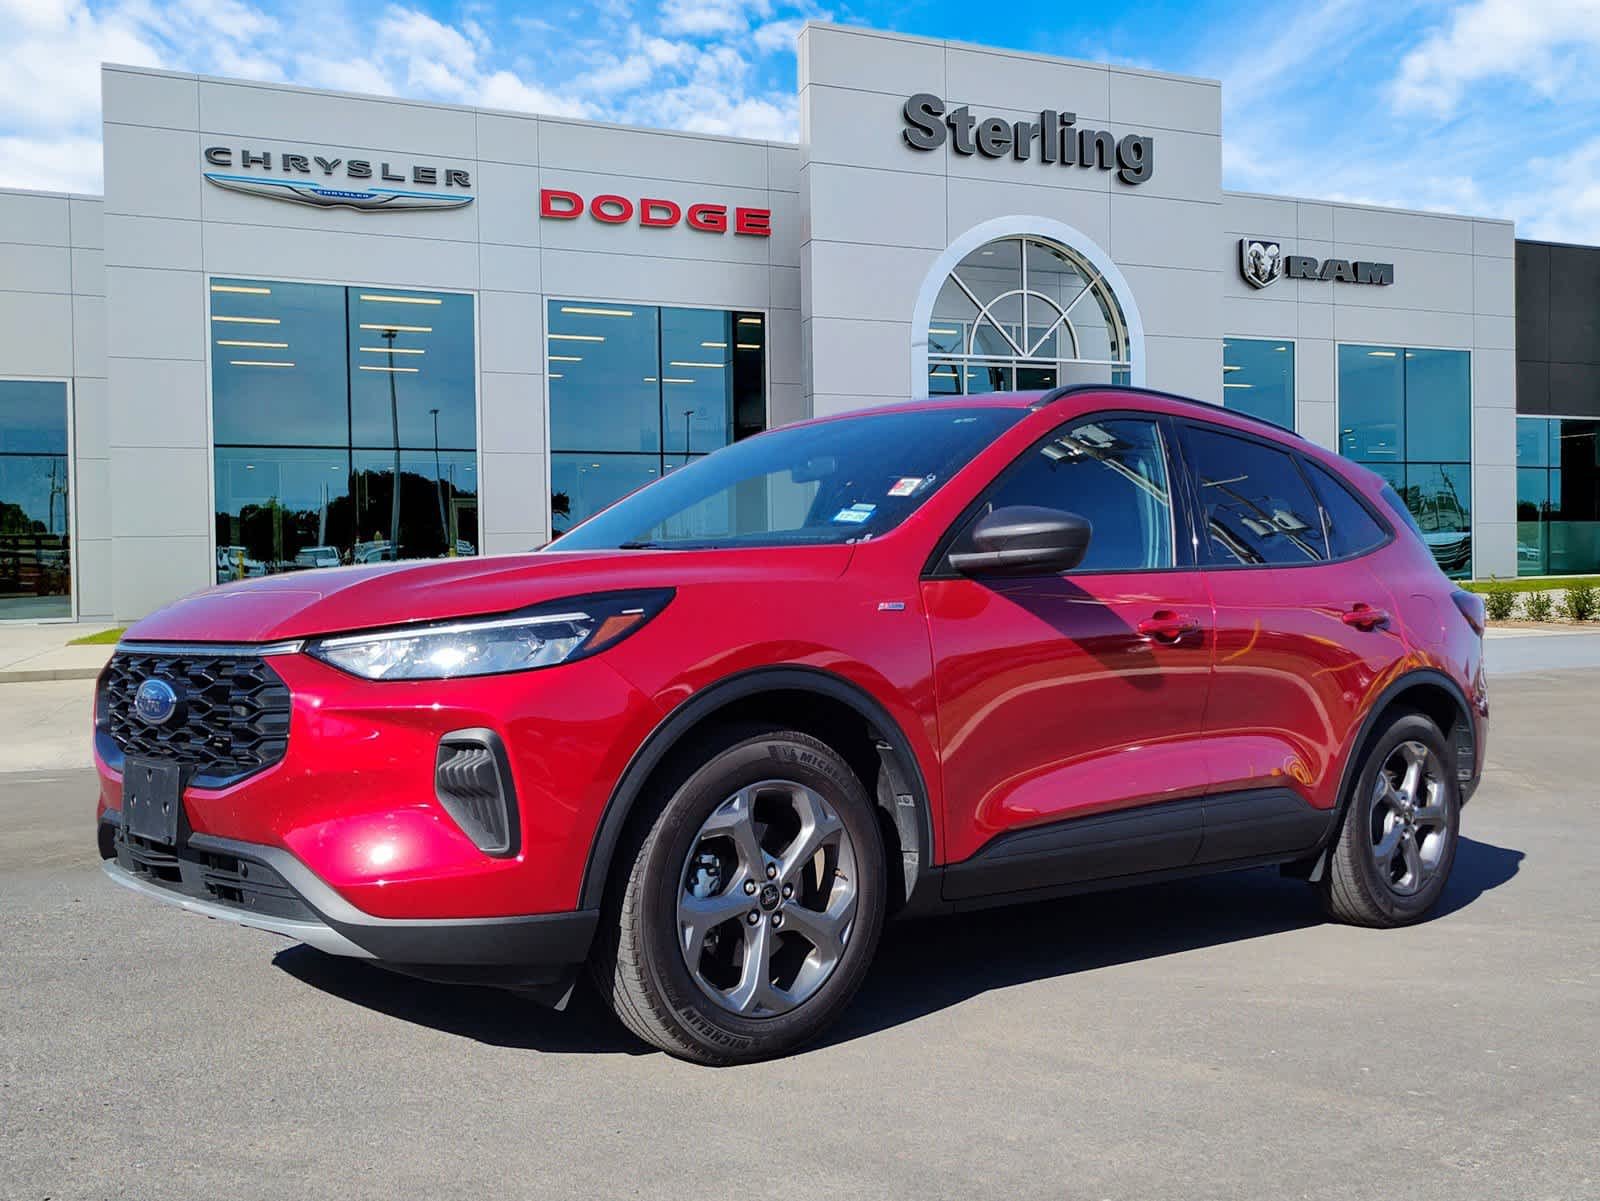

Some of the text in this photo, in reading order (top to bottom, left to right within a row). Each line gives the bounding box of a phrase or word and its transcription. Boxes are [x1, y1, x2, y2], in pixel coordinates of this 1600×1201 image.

[903, 93, 1154, 184] Sterling
[204, 146, 472, 187] CHRYSLER
[317, 190, 369, 198] CHRYSLER
[540, 188, 771, 237] DODGE
[1285, 255, 1394, 286] RAM
